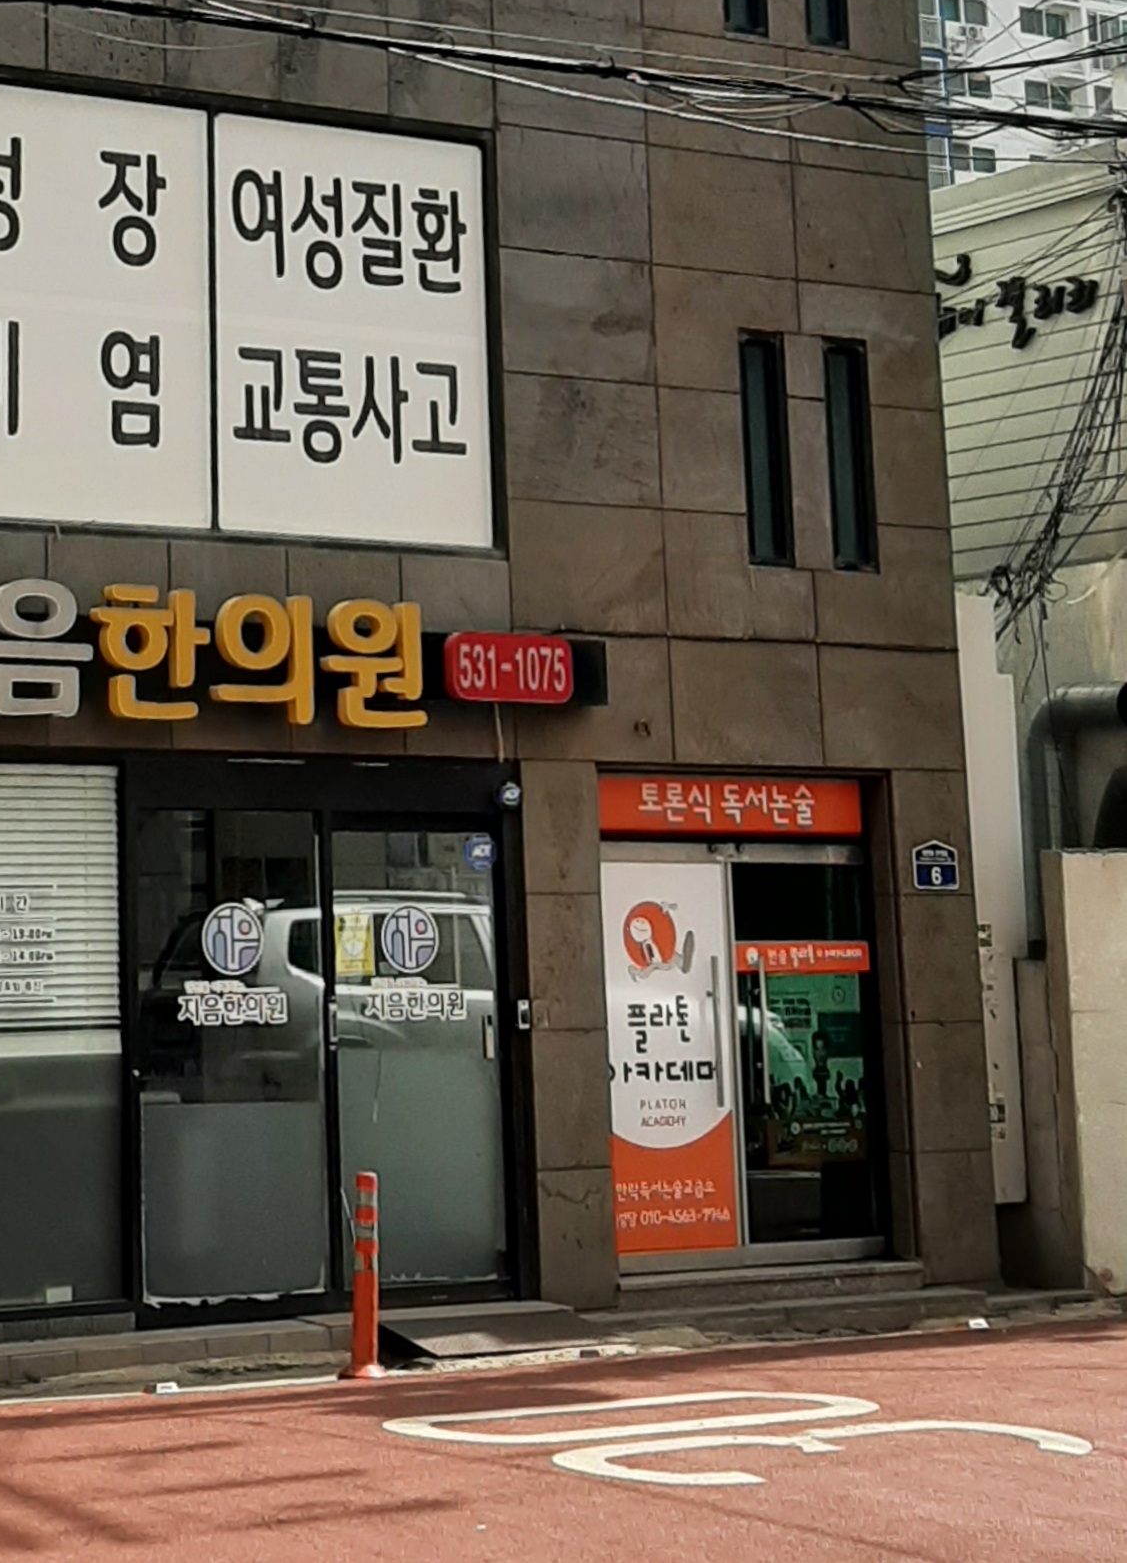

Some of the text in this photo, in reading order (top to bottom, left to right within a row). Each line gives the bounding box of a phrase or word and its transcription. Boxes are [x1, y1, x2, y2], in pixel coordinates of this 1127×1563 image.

[230, 168, 468, 294] 여성질환
[232, 344, 468, 464] 교통사고
[458, 642, 568, 694] 531-1075
[638, 782, 816, 828] 토론식 독서논술
[931, 866, 942, 885] 6
[178, 994, 288, 1025] 지음한의원
[366, 991, 466, 1019] 지음한의원
[628, 995, 691, 1054] 플라톤
